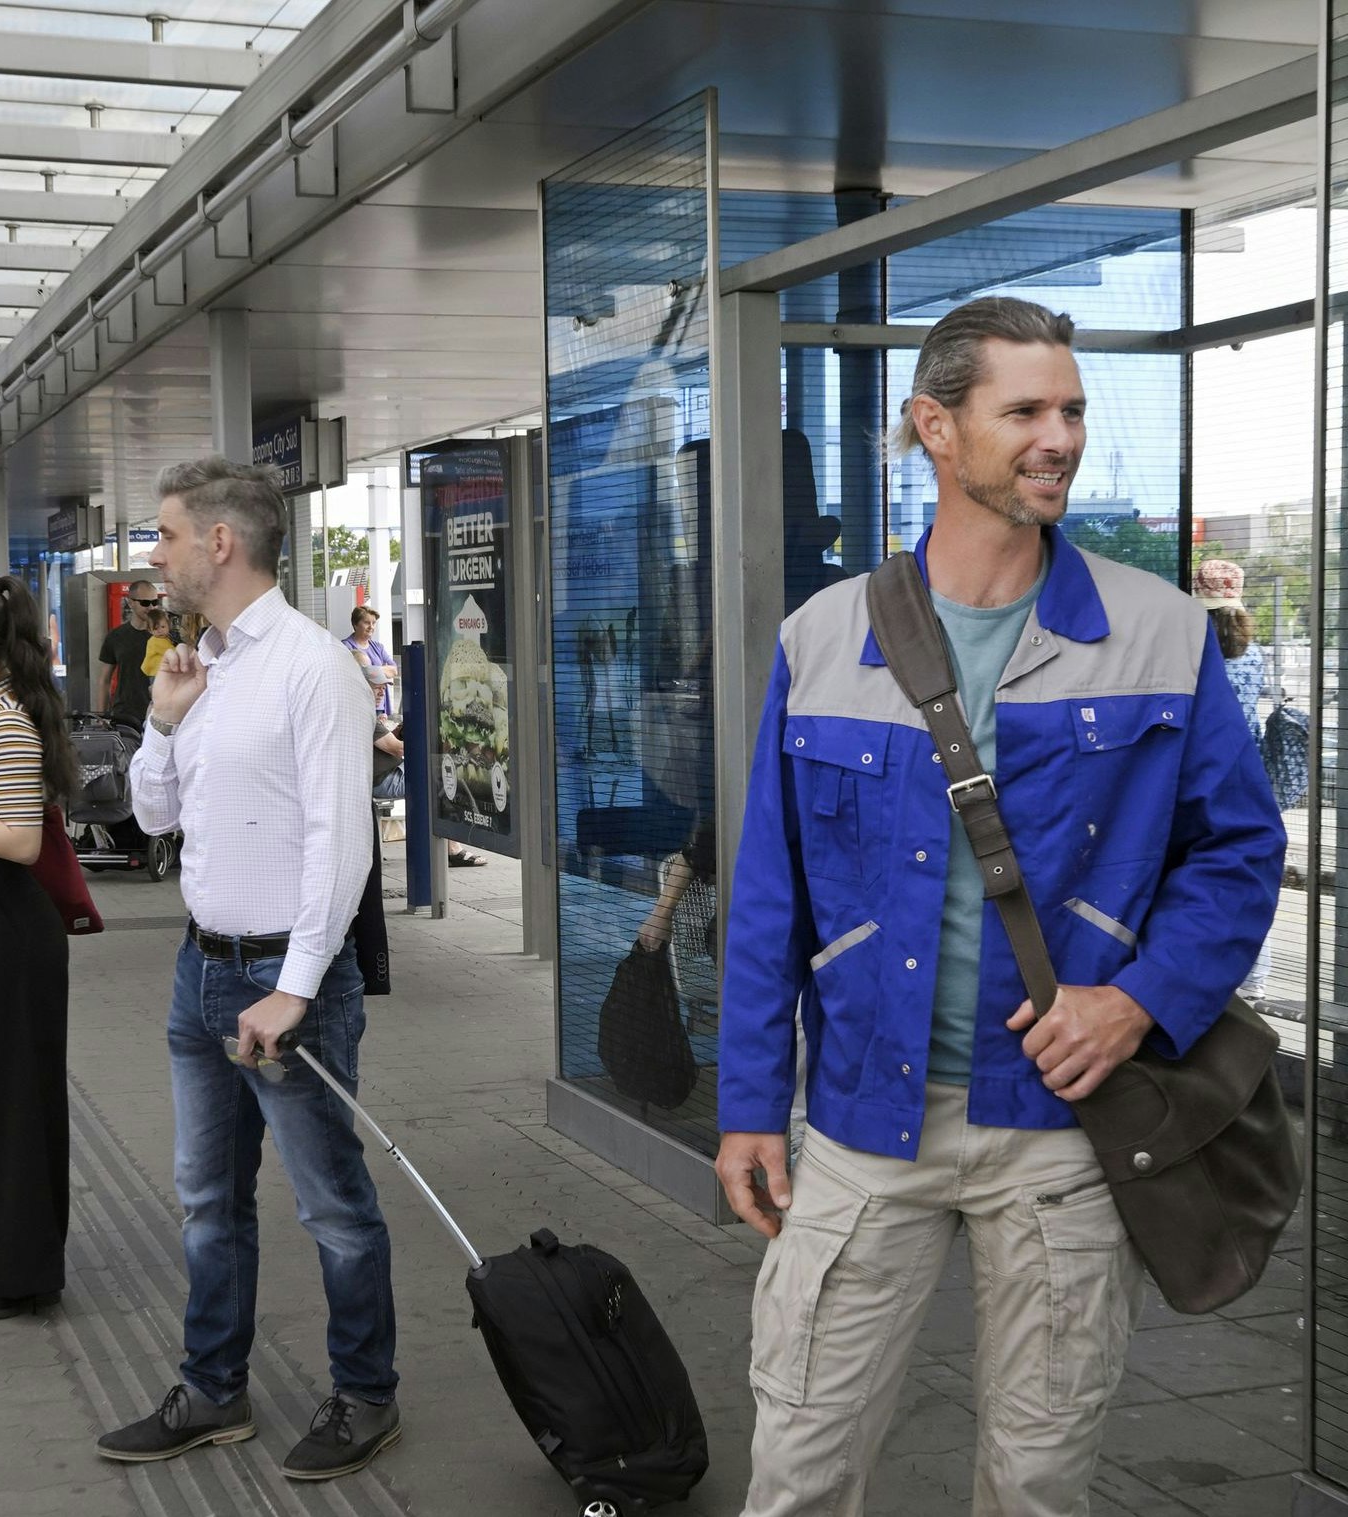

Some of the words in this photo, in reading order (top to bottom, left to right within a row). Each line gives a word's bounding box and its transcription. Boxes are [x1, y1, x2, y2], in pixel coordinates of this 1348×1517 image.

[253, 437, 272, 463] opping
[273, 433, 285, 459] City
[285, 424, 298, 451] Süd
[447, 511, 494, 547] BETTER
[448, 555, 495, 582] BURGERN.
[458, 617, 481, 629] EINGANG
